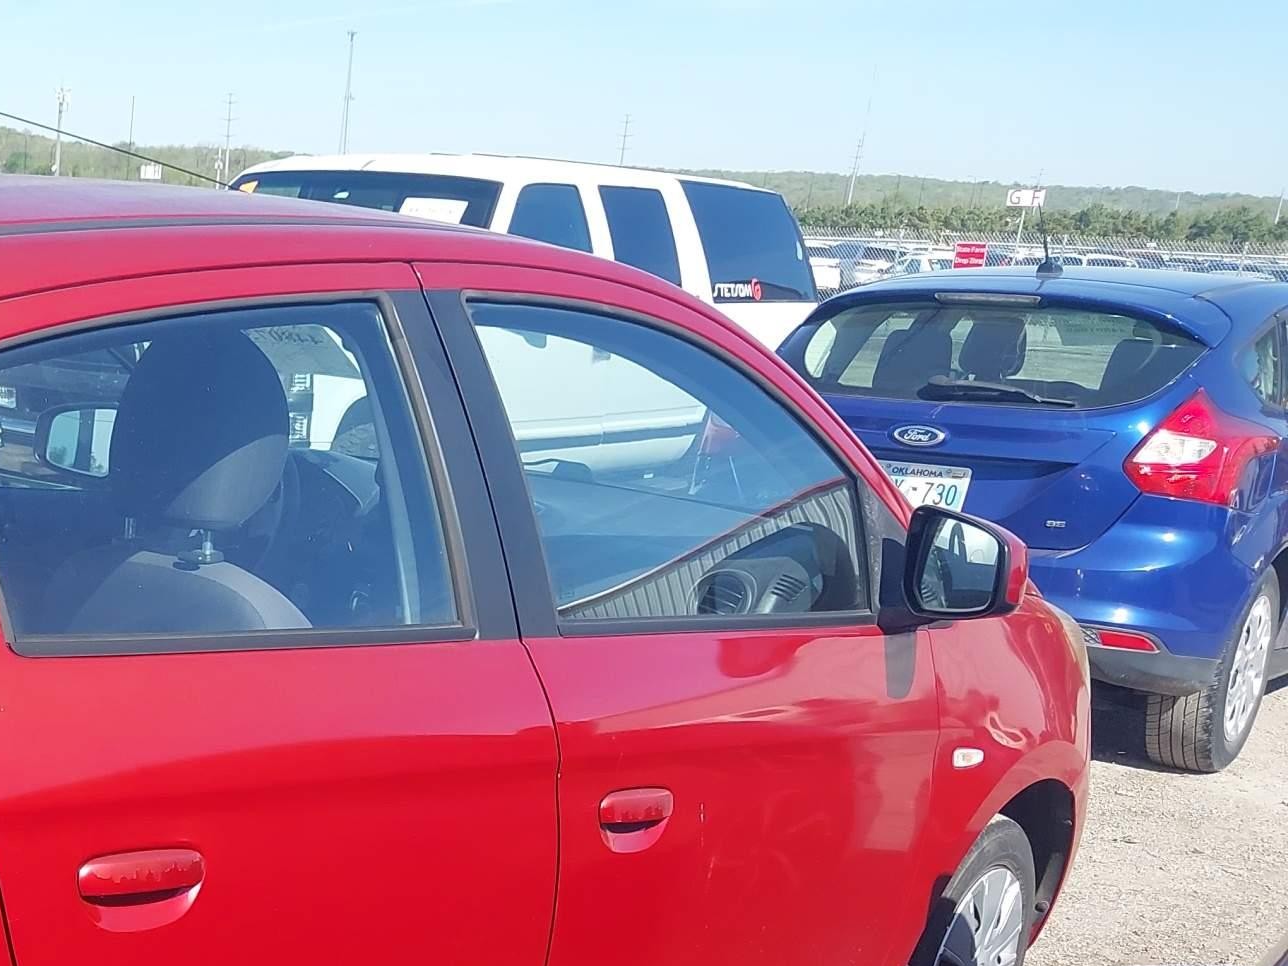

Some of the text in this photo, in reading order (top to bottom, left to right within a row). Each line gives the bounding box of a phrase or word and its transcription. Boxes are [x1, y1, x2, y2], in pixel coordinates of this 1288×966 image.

[1009, 189, 1021, 205] G
[903, 428, 931, 442] Ford
[892, 465, 944, 479] OKLAHOMA
